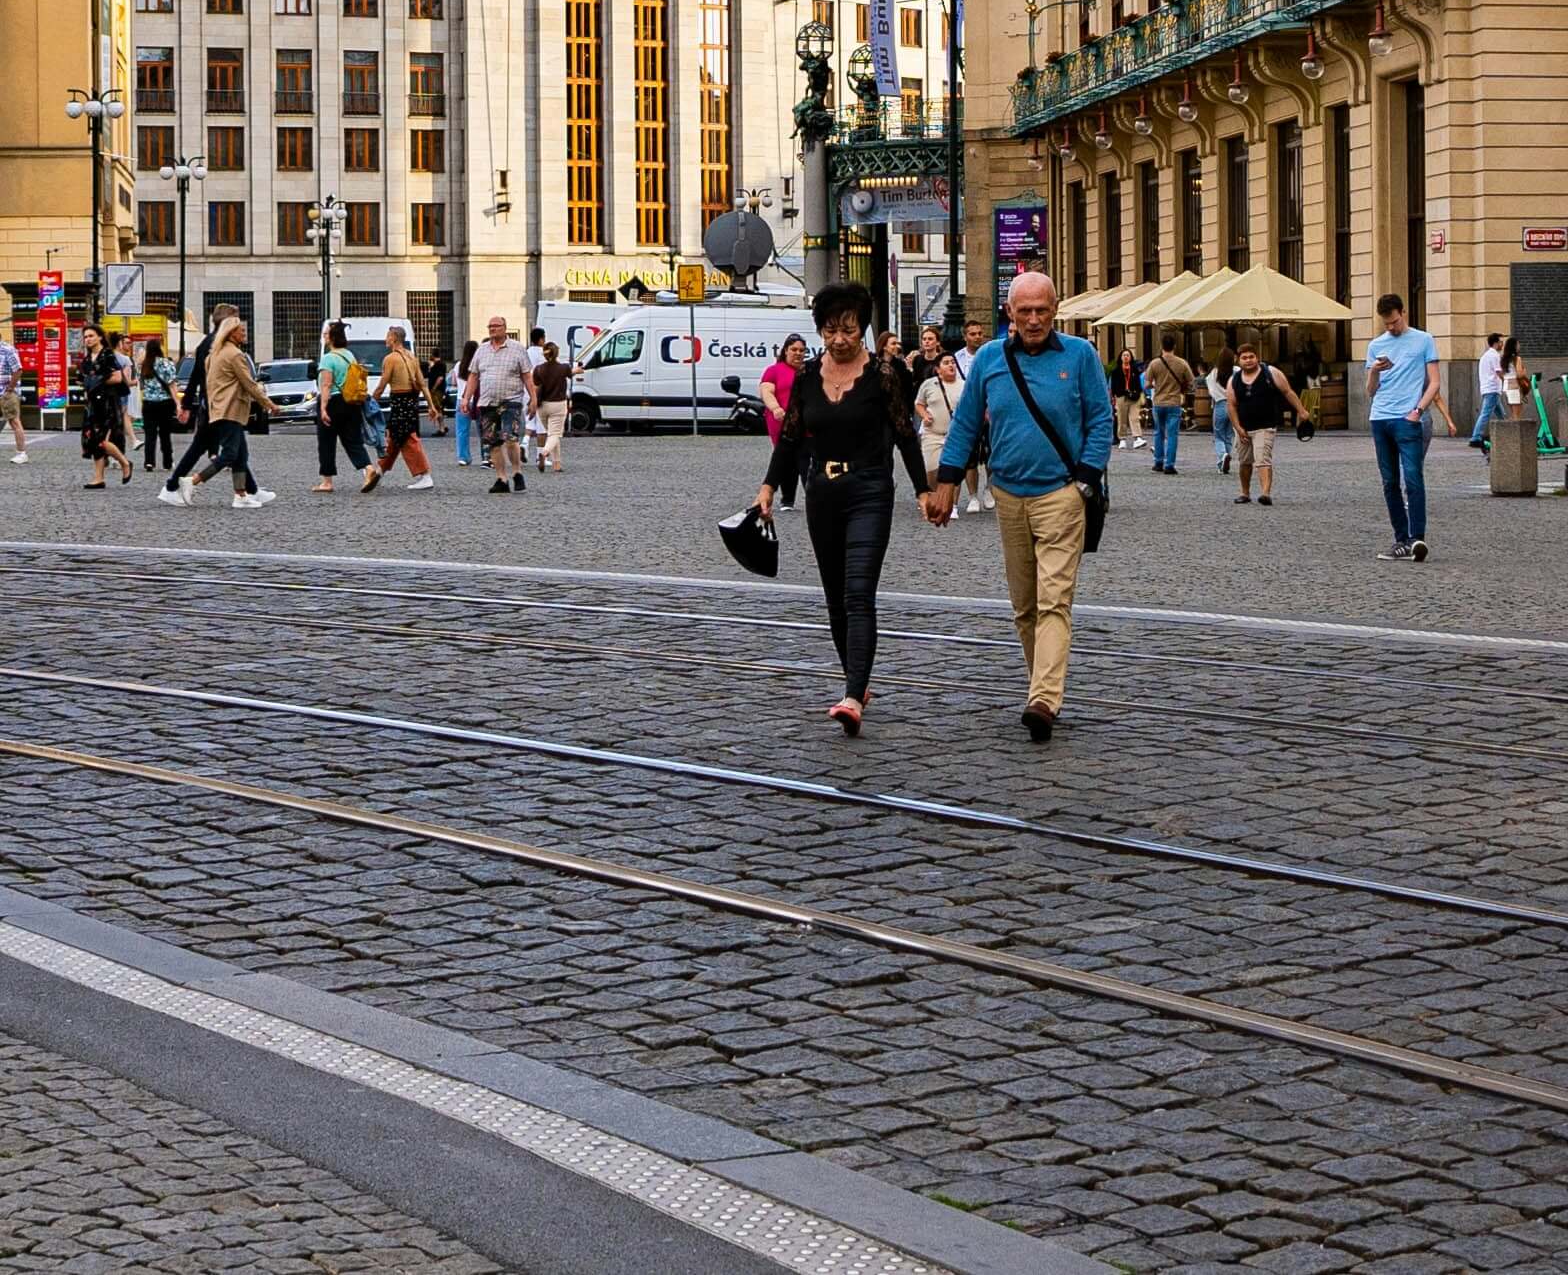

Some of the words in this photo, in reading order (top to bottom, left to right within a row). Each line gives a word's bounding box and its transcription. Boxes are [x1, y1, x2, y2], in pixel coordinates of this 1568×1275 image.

[880, 190, 903, 203] Tim
[565, 268, 612, 286] ČESKÁ
[42, 295, 59, 307] 01
[708, 339, 767, 358] Česká
